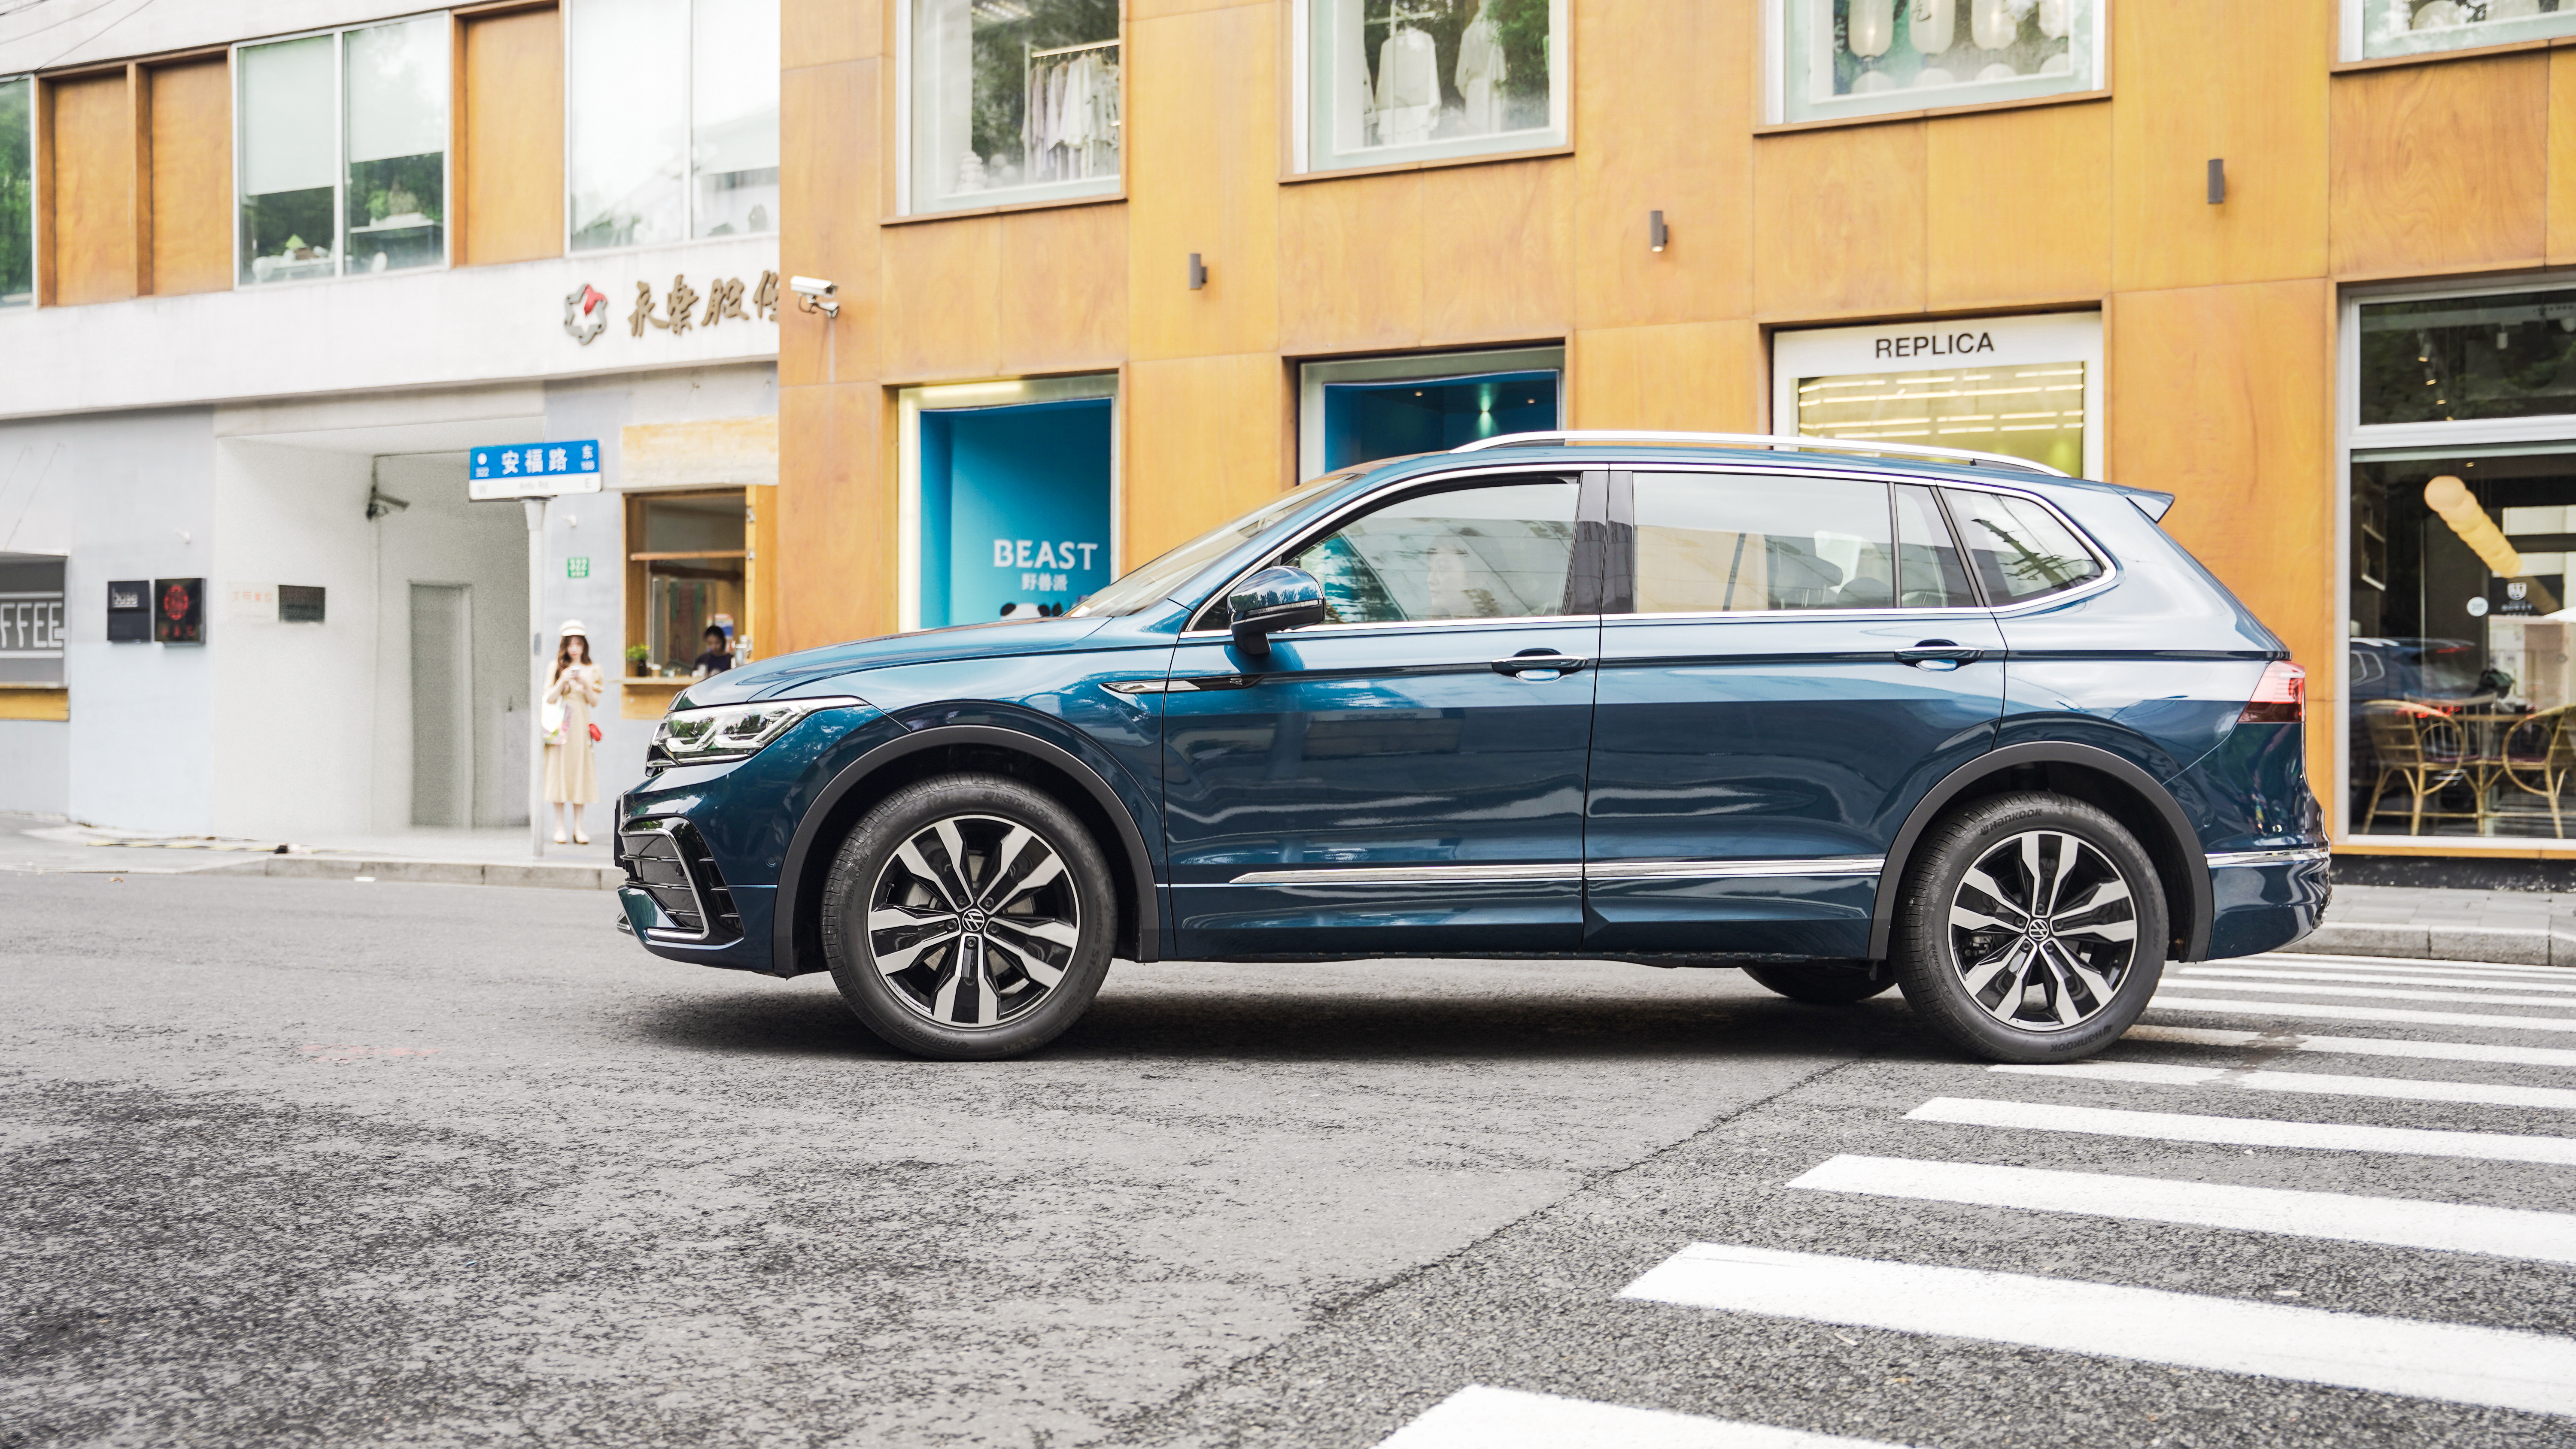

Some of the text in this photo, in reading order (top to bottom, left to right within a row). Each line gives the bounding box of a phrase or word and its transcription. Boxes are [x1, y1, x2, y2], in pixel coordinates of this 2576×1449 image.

[1876, 332, 1994, 358] REPLICA
[501, 447, 568, 475] 安福路
[477, 483, 488, 495] W
[584, 477, 592, 489] E
[993, 539, 1099, 570] BEAST
[1021, 572, 1068, 592] 野兽派
